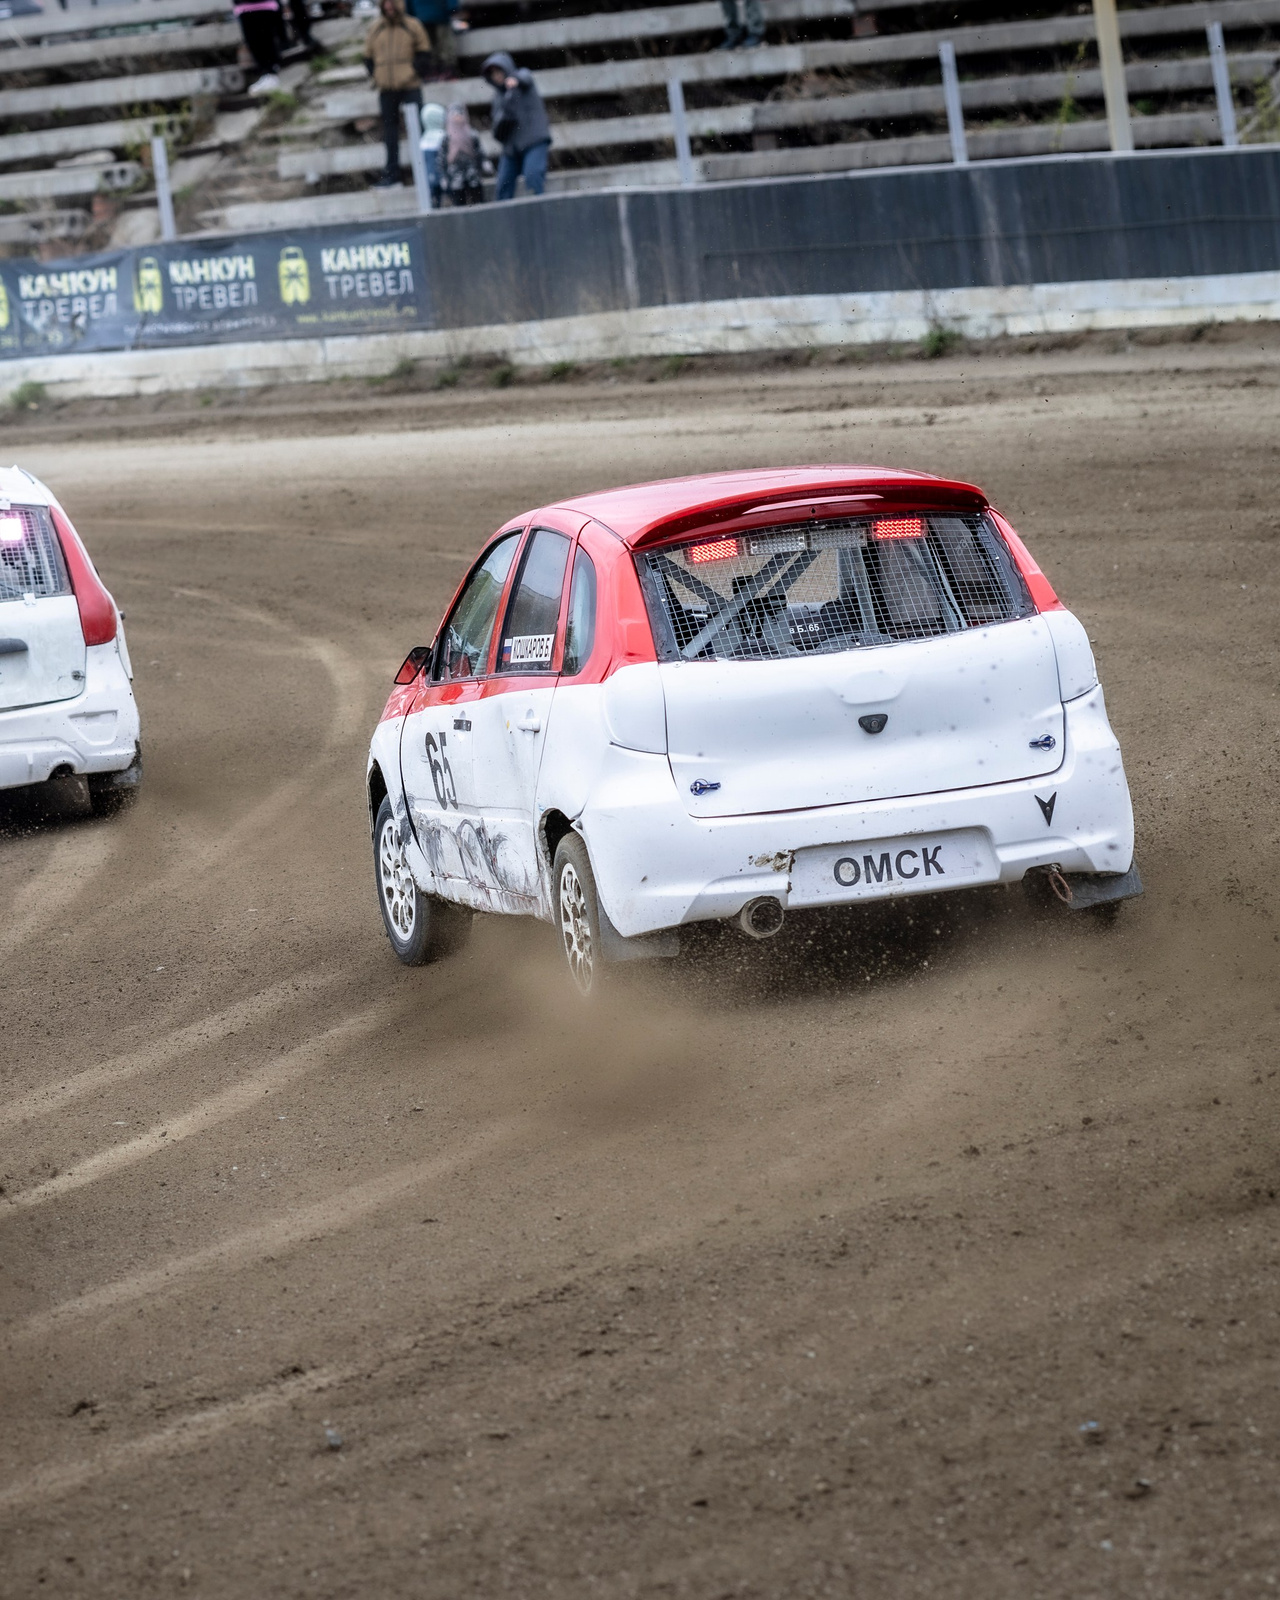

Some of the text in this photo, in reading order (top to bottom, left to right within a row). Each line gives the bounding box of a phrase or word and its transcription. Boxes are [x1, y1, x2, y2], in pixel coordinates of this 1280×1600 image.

[169, 255, 256, 285] КАНКУН
[321, 242, 411, 272] КАНКУН
[171, 281, 258, 311] ТРЕВЕЛ
[324, 269, 415, 299] ТРЕВЕЛ
[21, 293, 118, 329] ТРЕВЕЛ
[809, 623, 820, 632] 65
[425, 732, 458, 811] 65
[833, 845, 946, 887] ОМСК
